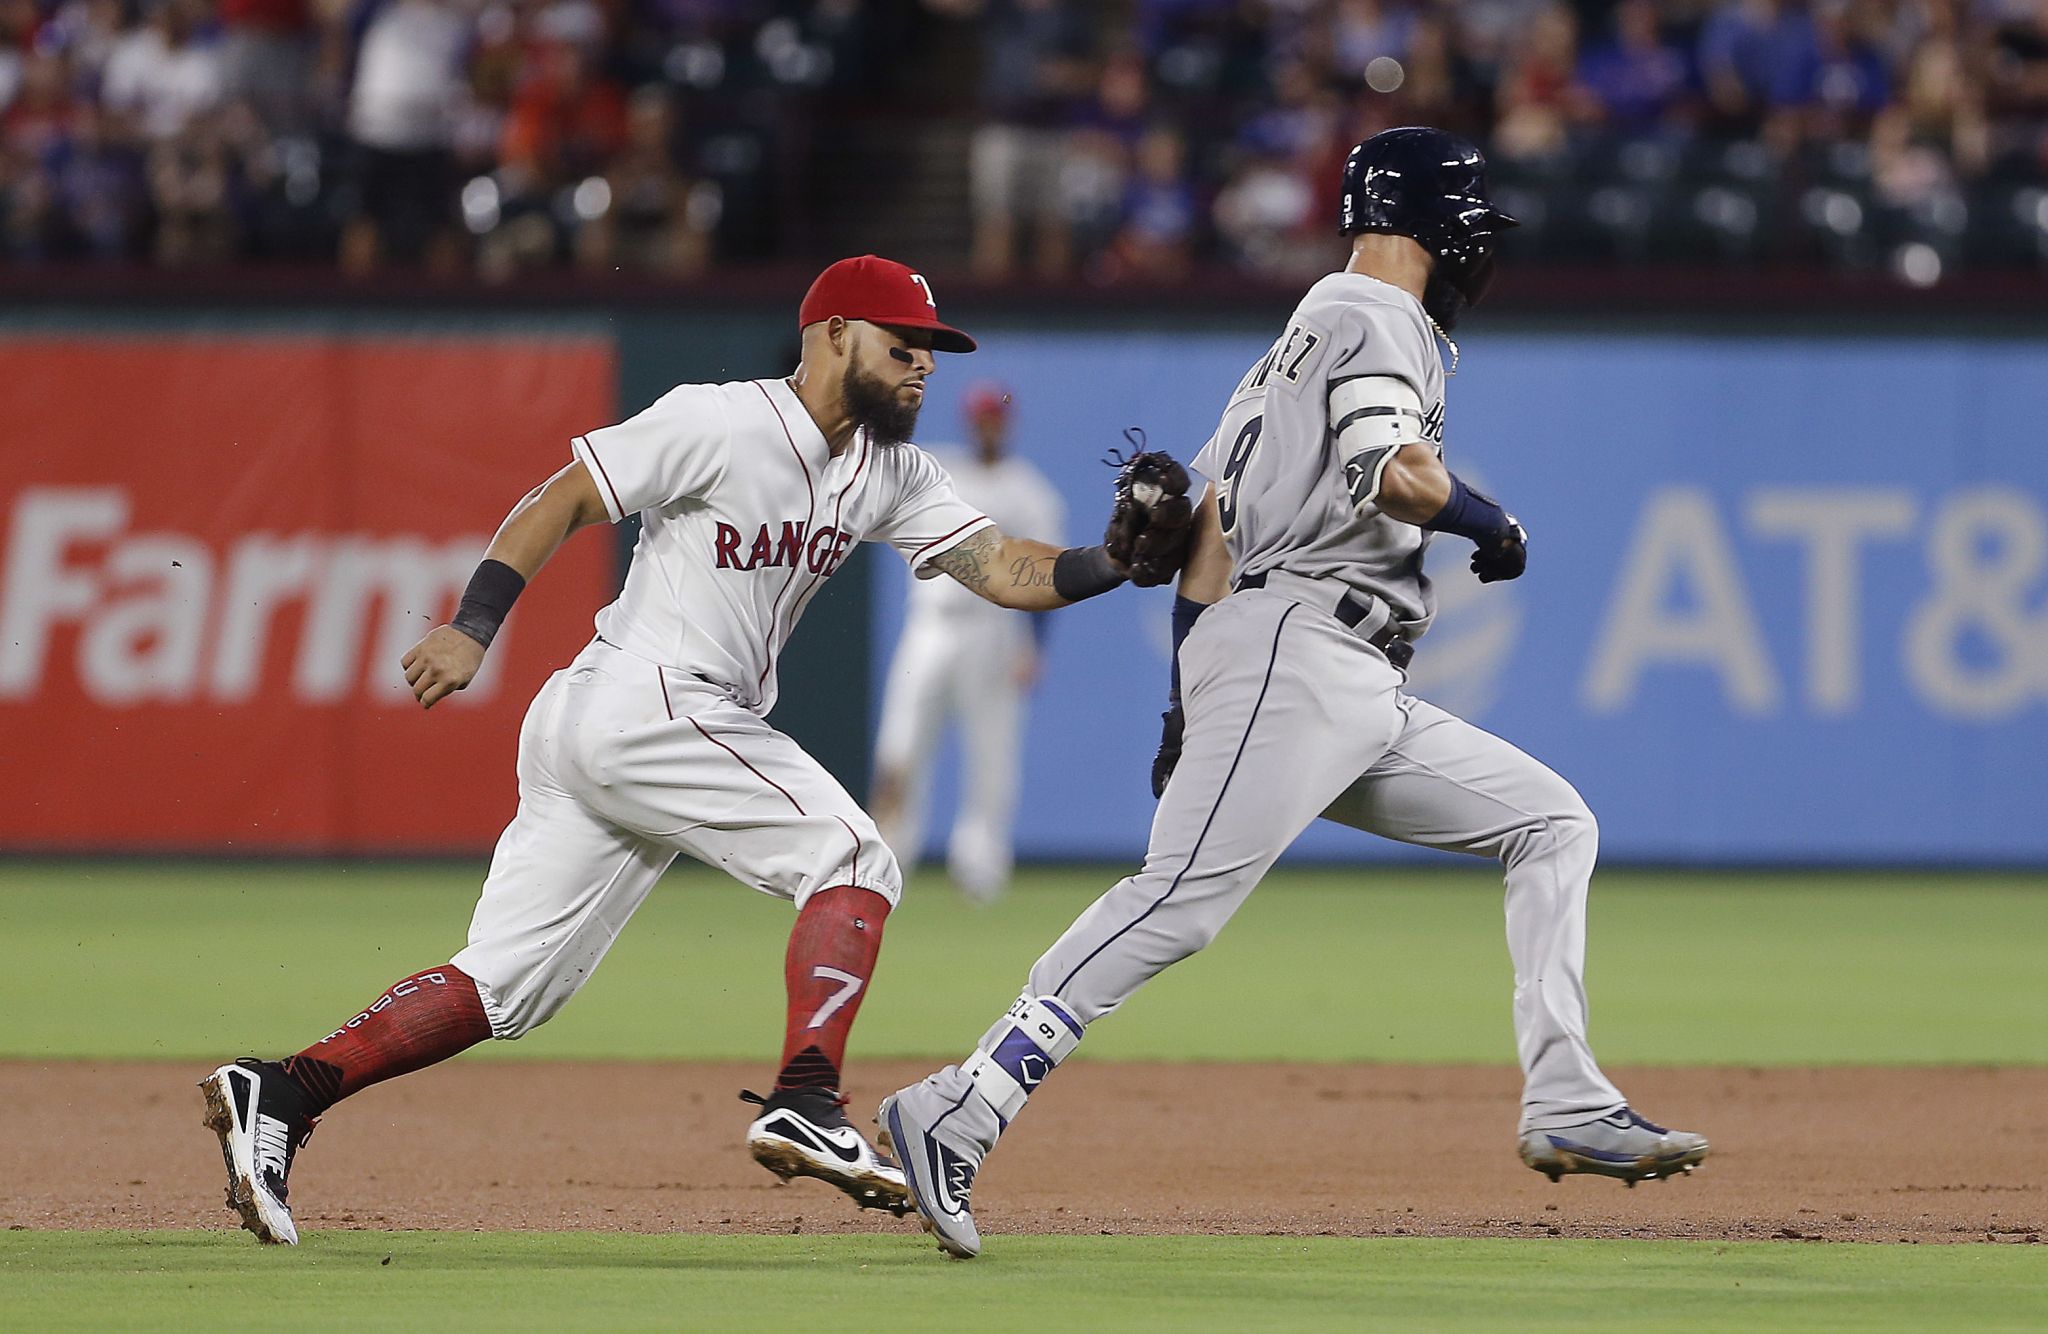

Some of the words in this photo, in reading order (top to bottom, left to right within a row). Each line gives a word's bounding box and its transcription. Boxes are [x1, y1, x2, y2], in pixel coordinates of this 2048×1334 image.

[1343, 194, 1352, 212] 9
[909, 274, 937, 308] T
[1217, 412, 1263, 536] 9
[714, 520, 853, 577] RANGE
[0, 488, 506, 704] Farm
[319, 971, 447, 1044] PUDGE
[806, 964, 864, 1029] 7
[1038, 1022, 1056, 1040] 9
[259, 1112, 289, 1181] NIKE
